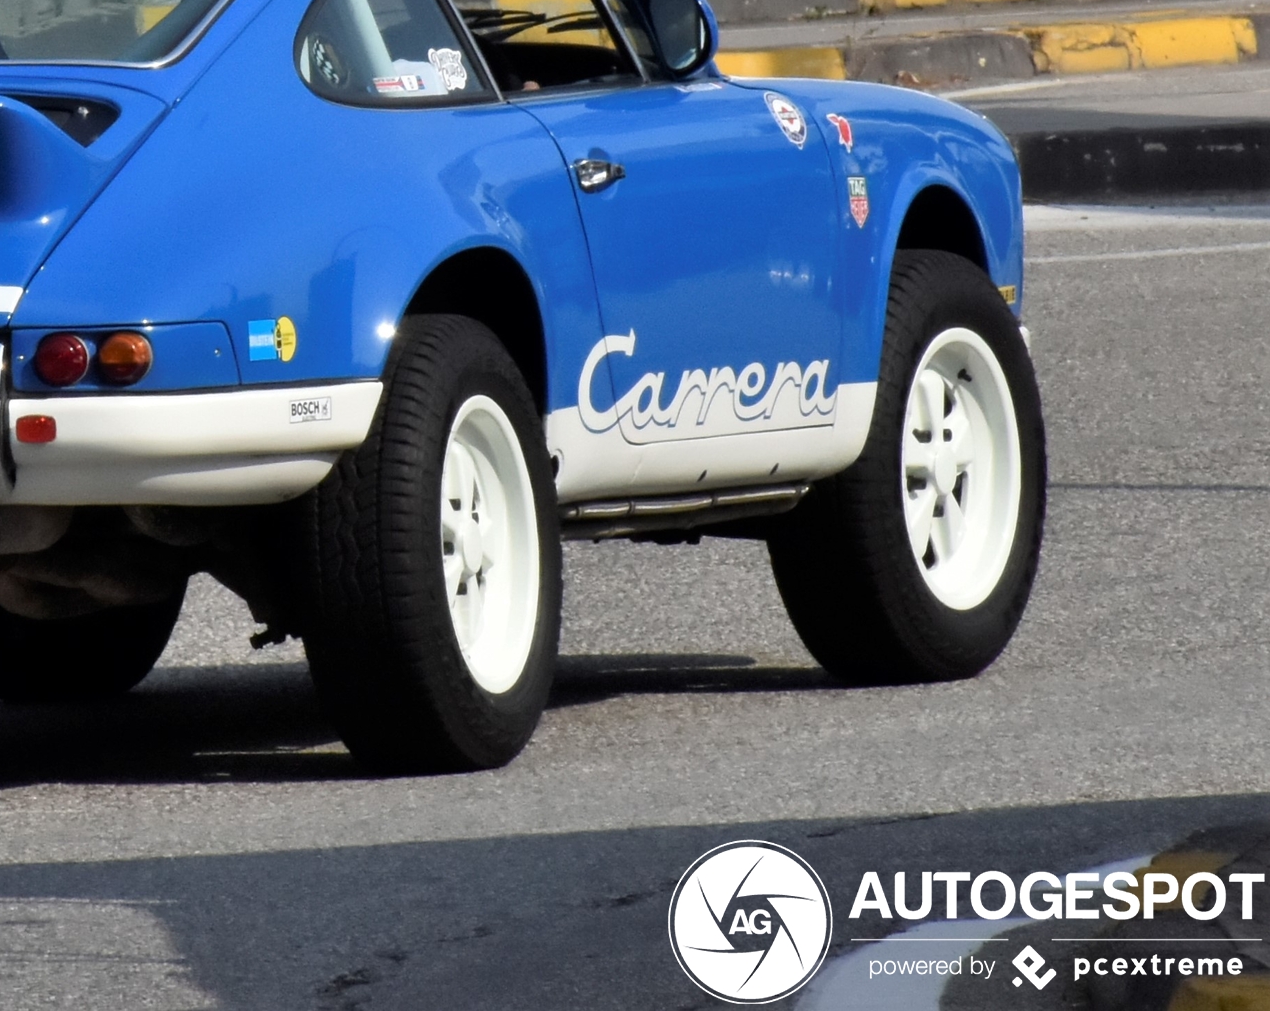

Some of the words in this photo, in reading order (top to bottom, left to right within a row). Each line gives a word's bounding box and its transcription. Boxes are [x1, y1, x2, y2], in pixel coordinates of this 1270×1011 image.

[849, 179, 866, 196] TAG
[578, 327, 837, 434] Carrera
[291, 400, 320, 416] BOSCH
